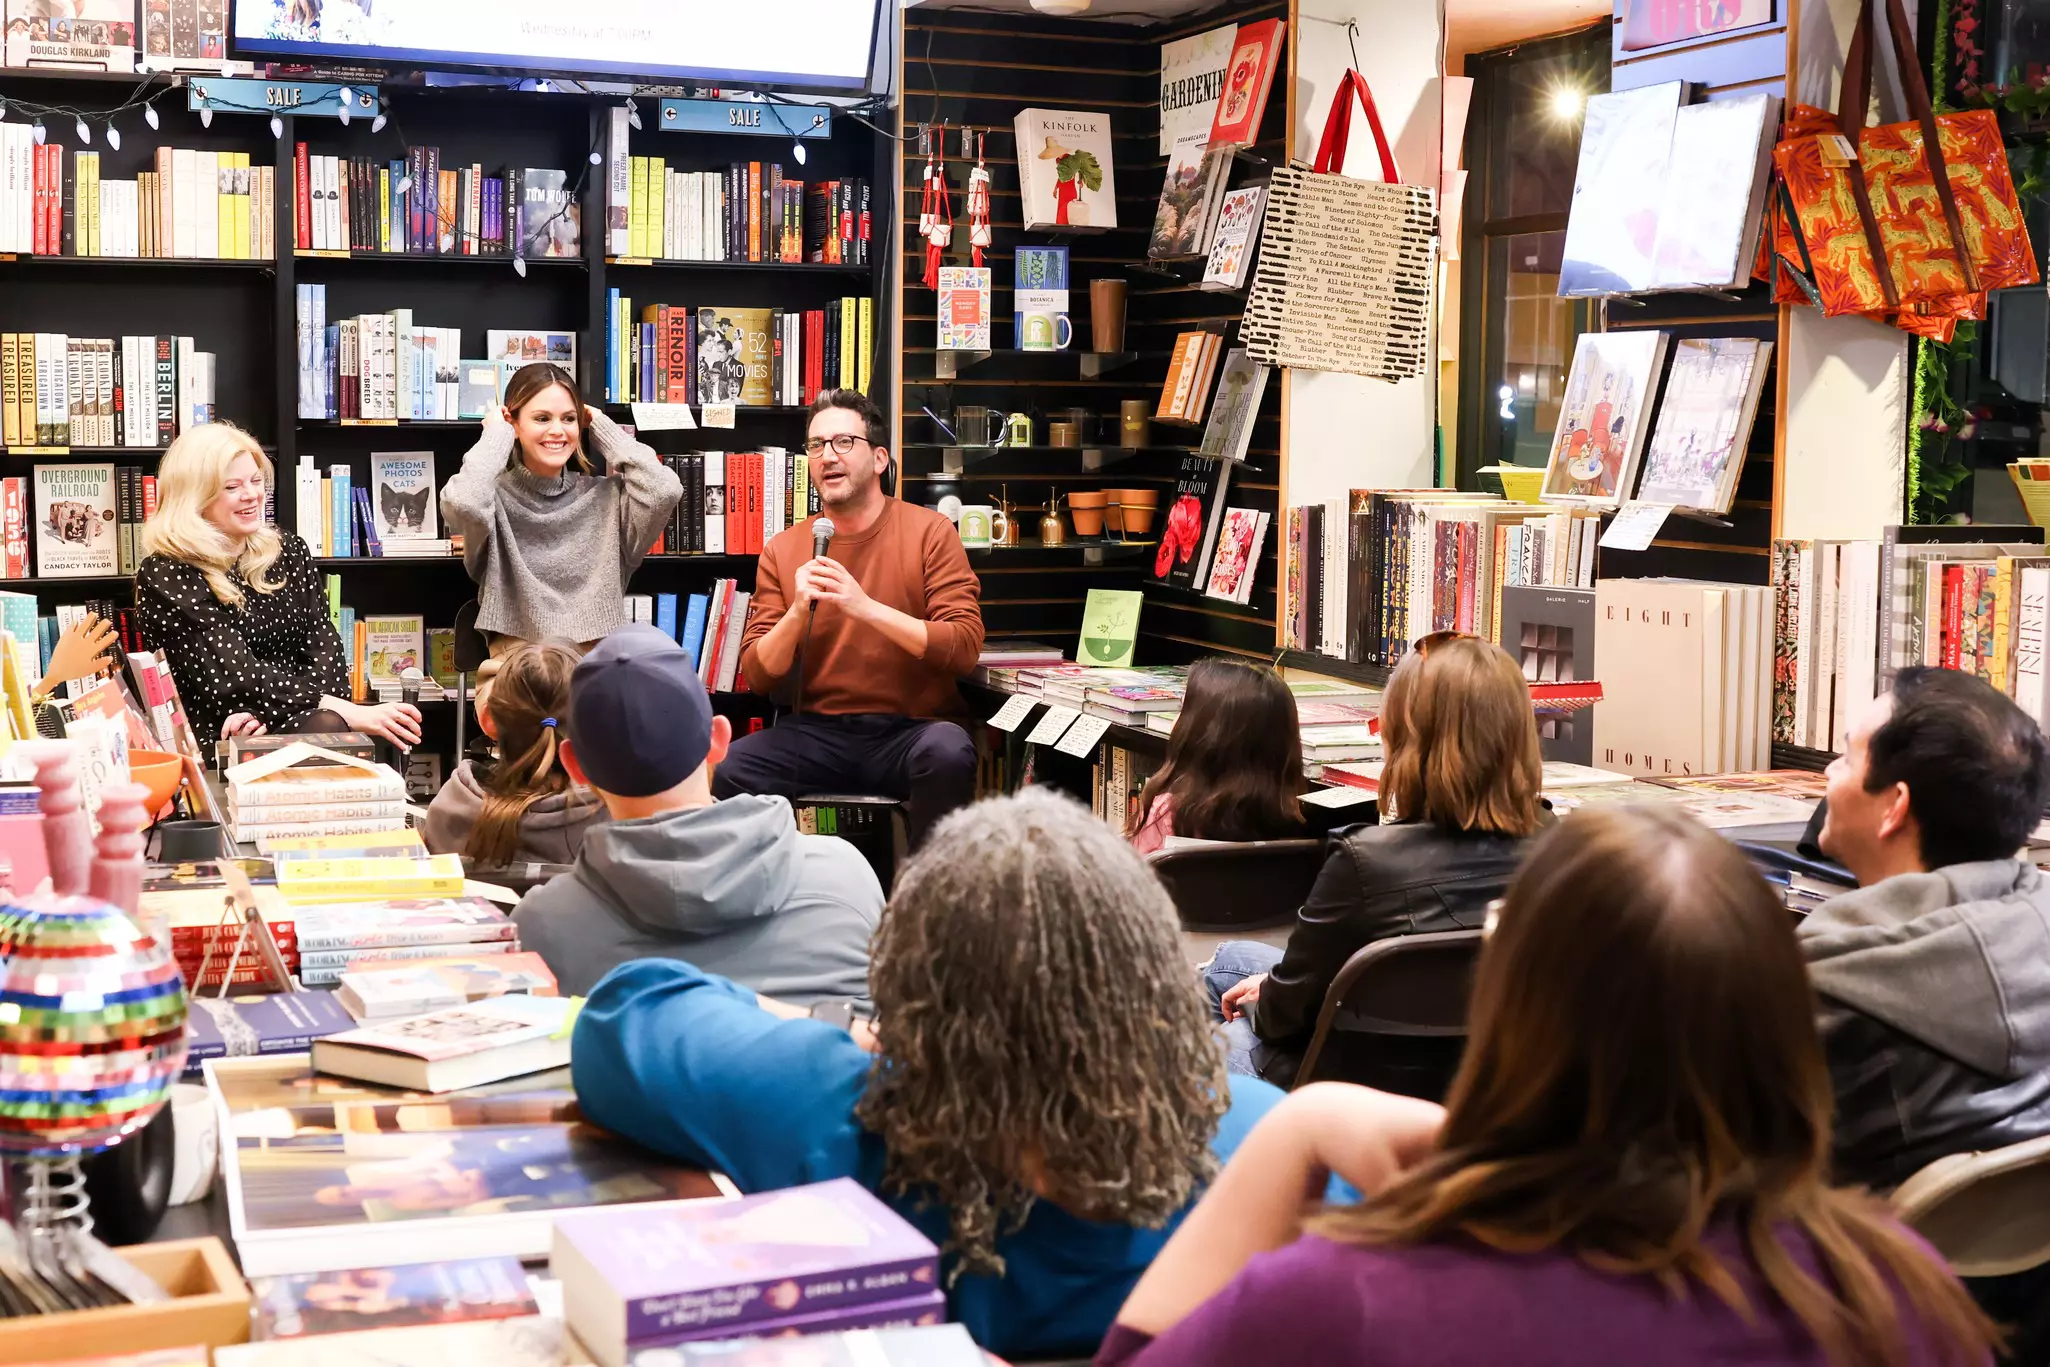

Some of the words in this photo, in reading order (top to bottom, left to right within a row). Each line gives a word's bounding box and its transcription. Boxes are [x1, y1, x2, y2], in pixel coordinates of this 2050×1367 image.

[520, 19, 589, 39] Wednesday
[30, 44, 68, 58] DOUGLAS
[70, 45, 111, 59] KIRKLAND
[266, 87, 301, 107] SALE
[729, 107, 761, 128] SALE
[1043, 120, 1098, 133] KINFOLK
[1177, 132, 1207, 144] DREAMSCAPES
[633, 164, 646, 196] SHY
[649, 164, 662, 197] SHY
[1306, 176, 1331, 185] Catcher
[473, 170, 481, 209] REVENANT
[526, 187, 545, 201] TOM
[547, 190, 577, 203] WOLFE
[1302, 184, 1336, 195] Sorcerer's
[1367, 193, 1385, 202] Heart
[752, 188, 760, 226] Connolly
[1303, 202, 1315, 210] Son
[1324, 206, 1355, 215] Nineteen
[1343, 199, 1362, 207] James
[1329, 215, 1346, 224] Song
[1357, 219, 1384, 229] Solomon
[1311, 231, 1349, 241] Handmaid's
[1350, 236, 1365, 244] Tale
[1296, 247, 1319, 256] Tropic
[1329, 252, 1352, 260] Cancer
[1361, 255, 1387, 264] Ulysses
[1340, 244, 1365, 252] Satanic
[1321, 268, 1351, 278] Farewell
[1340, 262, 1383, 273] Mockingbird
[1286, 281, 1305, 290] Black
[1306, 283, 1318, 292] Boy
[1327, 287, 1354, 296] Blubber
[1363, 292, 1383, 300] Brave
[1302, 274, 1318, 282] Finn
[1353, 281, 1373, 291] King's
[1375, 284, 1388, 292] Men
[1296, 291, 1322, 300] Flowers
[1336, 297, 1367, 308] Algernon
[1282, 316, 1304, 325] Native
[1289, 308, 1322, 318] Invisible
[302, 301, 310, 343] Penguins
[314, 301, 323, 343] Penguins
[670, 316, 684, 381] RENOIR
[748, 332, 767, 353] 52
[3, 340, 16, 404] TREASURED
[21, 340, 33, 404] TREASURED
[363, 359, 371, 378] DOG
[726, 364, 768, 378] MOVIES
[115, 387, 123, 411] ASYLUM
[157, 362, 172, 419] BERLIN
[363, 378, 371, 404] BREED
[380, 461, 427, 470] AWESOME
[765, 457, 773, 477] AND
[1181, 456, 1214, 472] BEAUTY
[42, 469, 108, 484] OVERGROUND
[384, 469, 423, 477] PHOTOS
[51, 484, 99, 498] RAILROAD
[393, 480, 416, 488] CATS
[1177, 480, 1207, 494] BLOOM
[785, 490, 793, 515] BOOKER
[1607, 605, 1690, 628] EIGHT
[368, 621, 376, 633] THE
[378, 621, 399, 632] AFRICAN
[1838, 630, 1847, 680] ARNOLD
[1606, 749, 1690, 776] HOMES
[266, 788, 319, 803] Atomic
[325, 786, 372, 799] Habits
[266, 807, 319, 821] Atomic
[325, 804, 372, 818] Habits
[266, 829, 319, 839] Atomic
[325, 825, 372, 836] Habits
